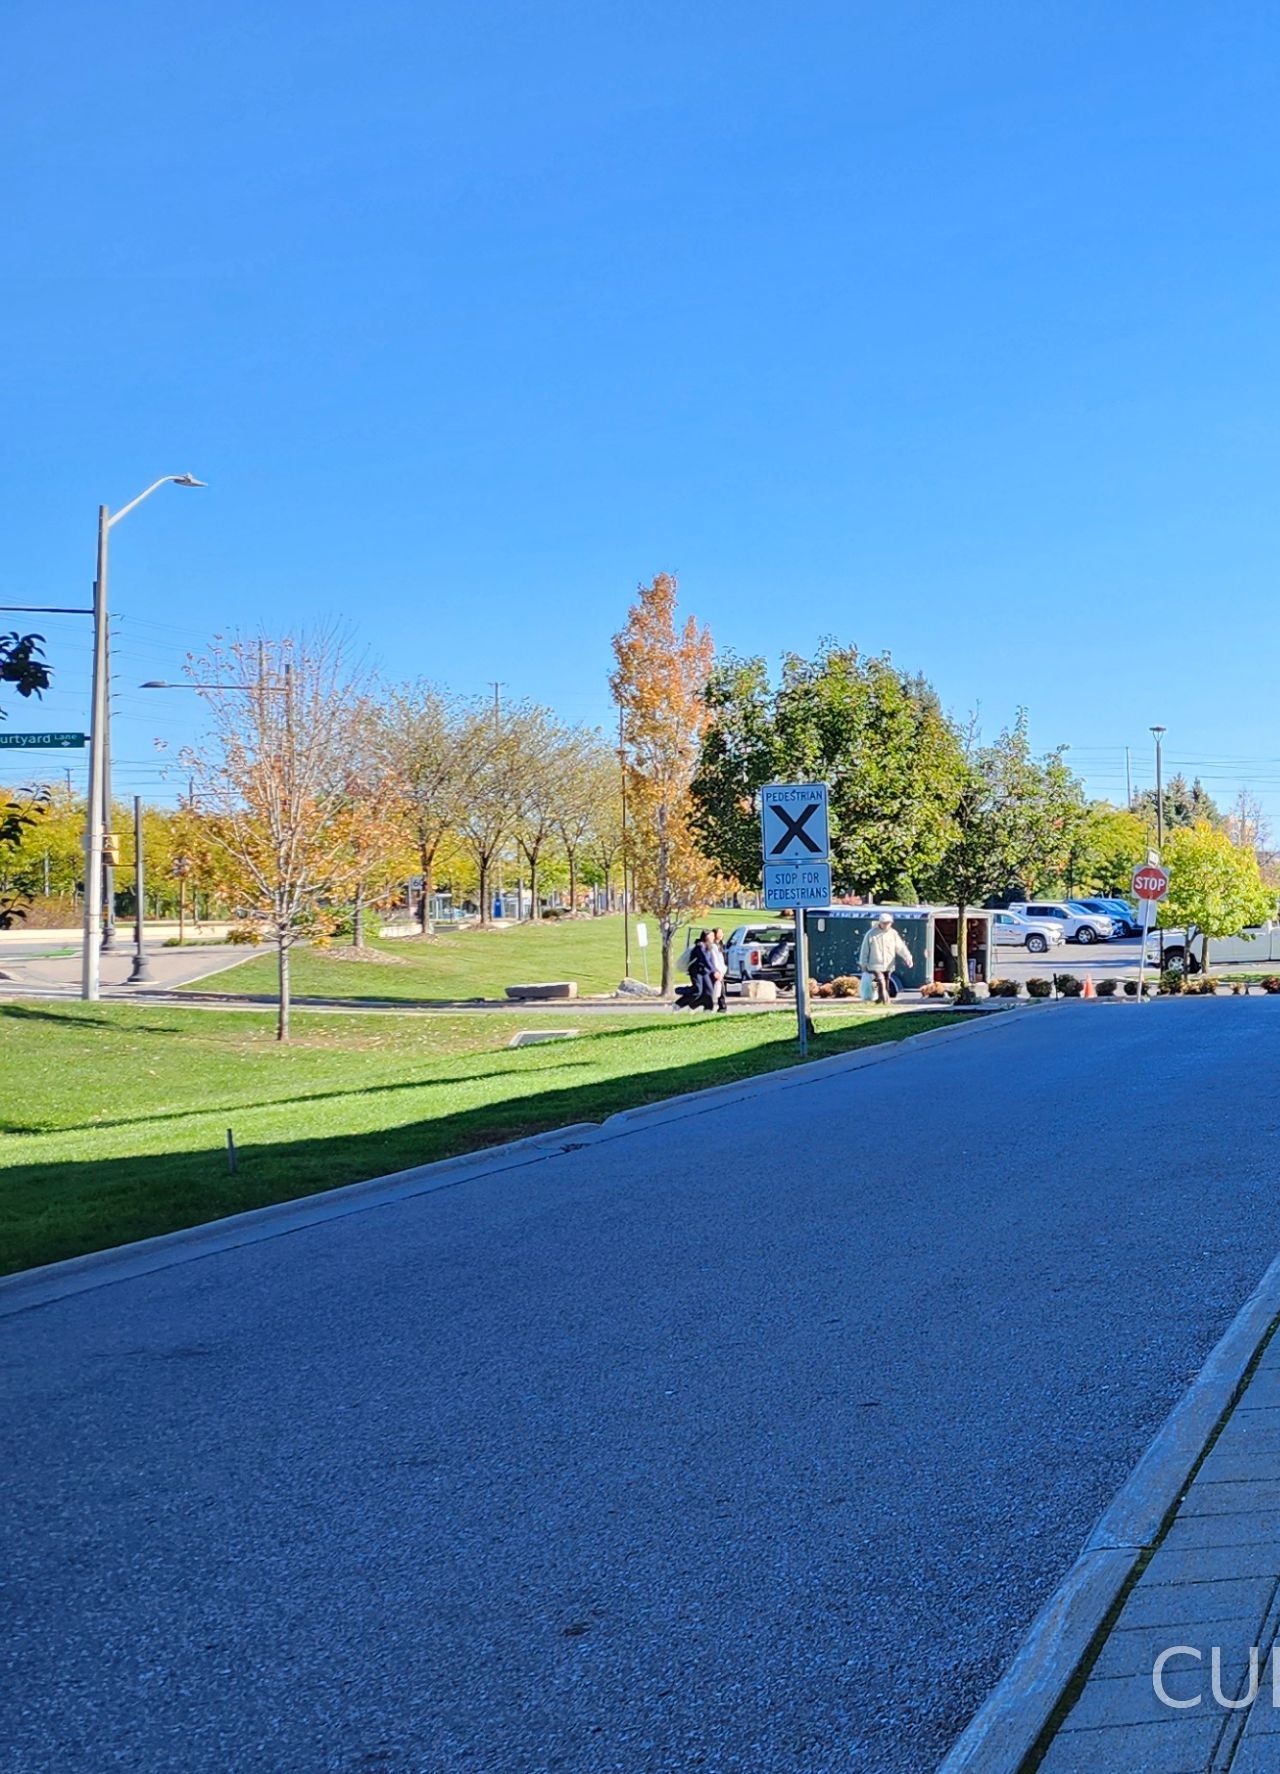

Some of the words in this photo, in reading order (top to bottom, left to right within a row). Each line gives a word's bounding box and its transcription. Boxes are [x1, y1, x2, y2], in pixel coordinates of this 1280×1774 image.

[0, 734, 51, 746] urtyard
[766, 790, 823, 802] PEDESTRIAN
[775, 873, 798, 885] STOP
[802, 872, 819, 884] FOR
[1134, 876, 1166, 892] STOP
[768, 886, 828, 900] PEDESTRIANS
